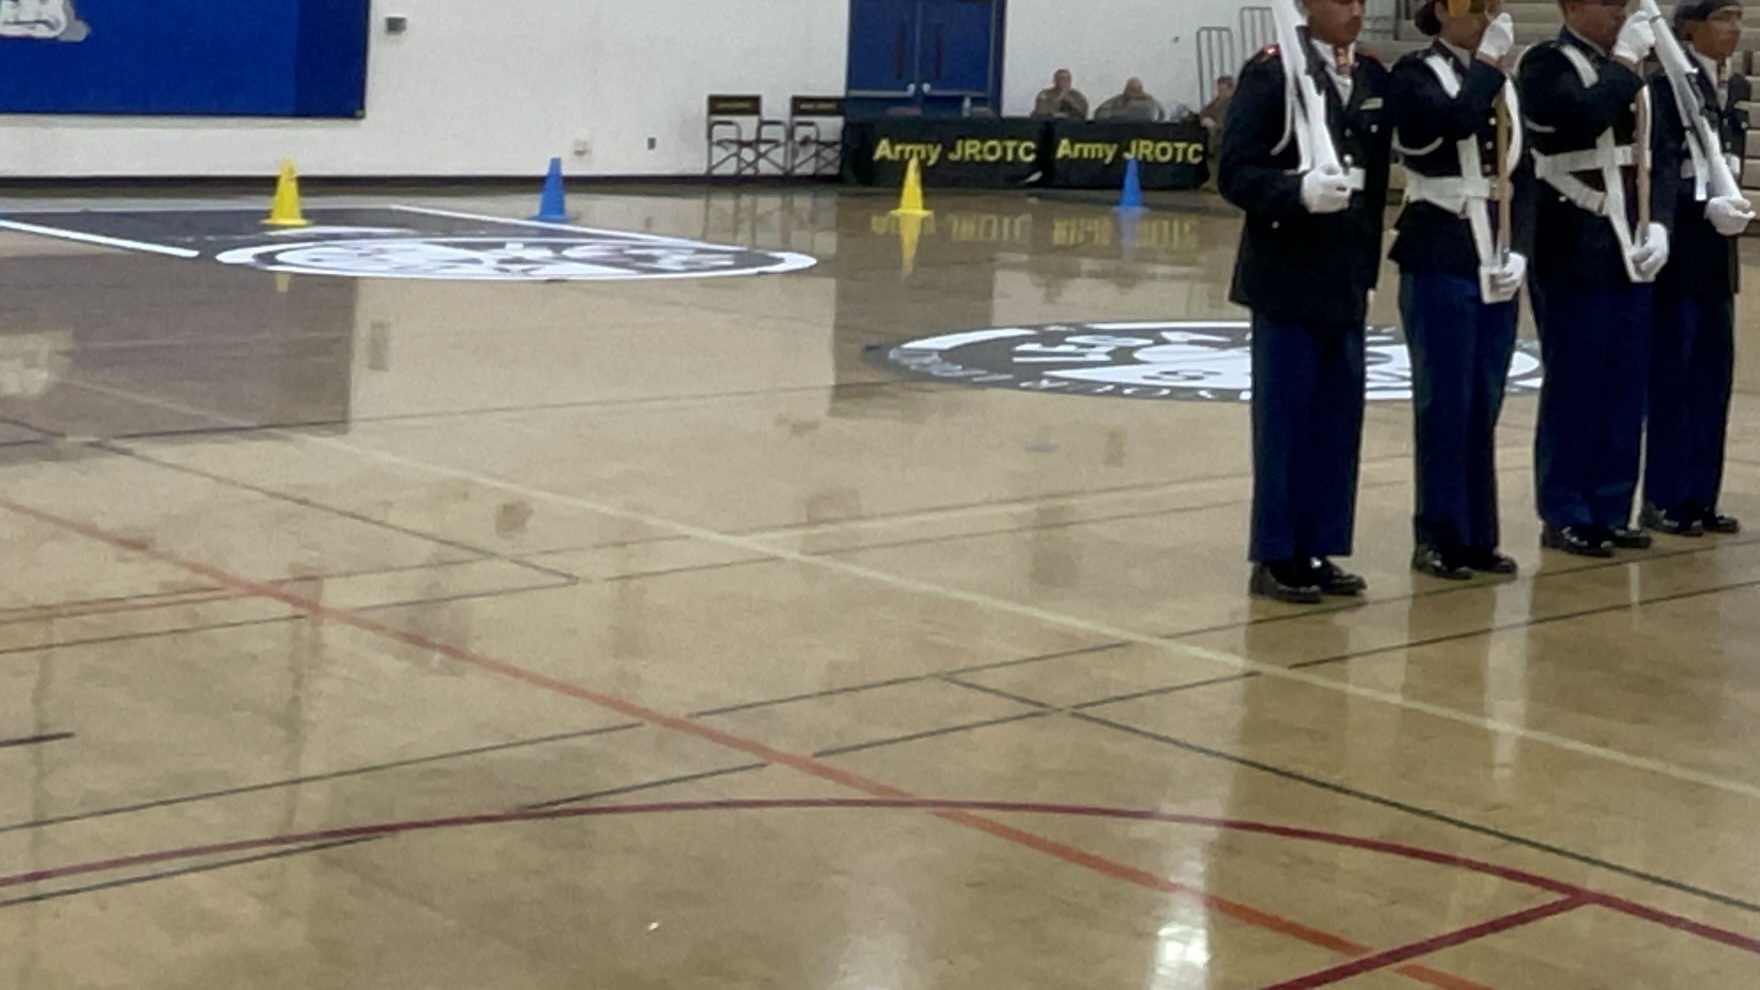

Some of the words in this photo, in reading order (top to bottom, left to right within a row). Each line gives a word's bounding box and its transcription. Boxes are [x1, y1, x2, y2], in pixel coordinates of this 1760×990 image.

[873, 137, 943, 167] Army
[948, 138, 1038, 163] JROTC
[1055, 137, 1119, 166] Army
[1123, 138, 1205, 163] JROTC
